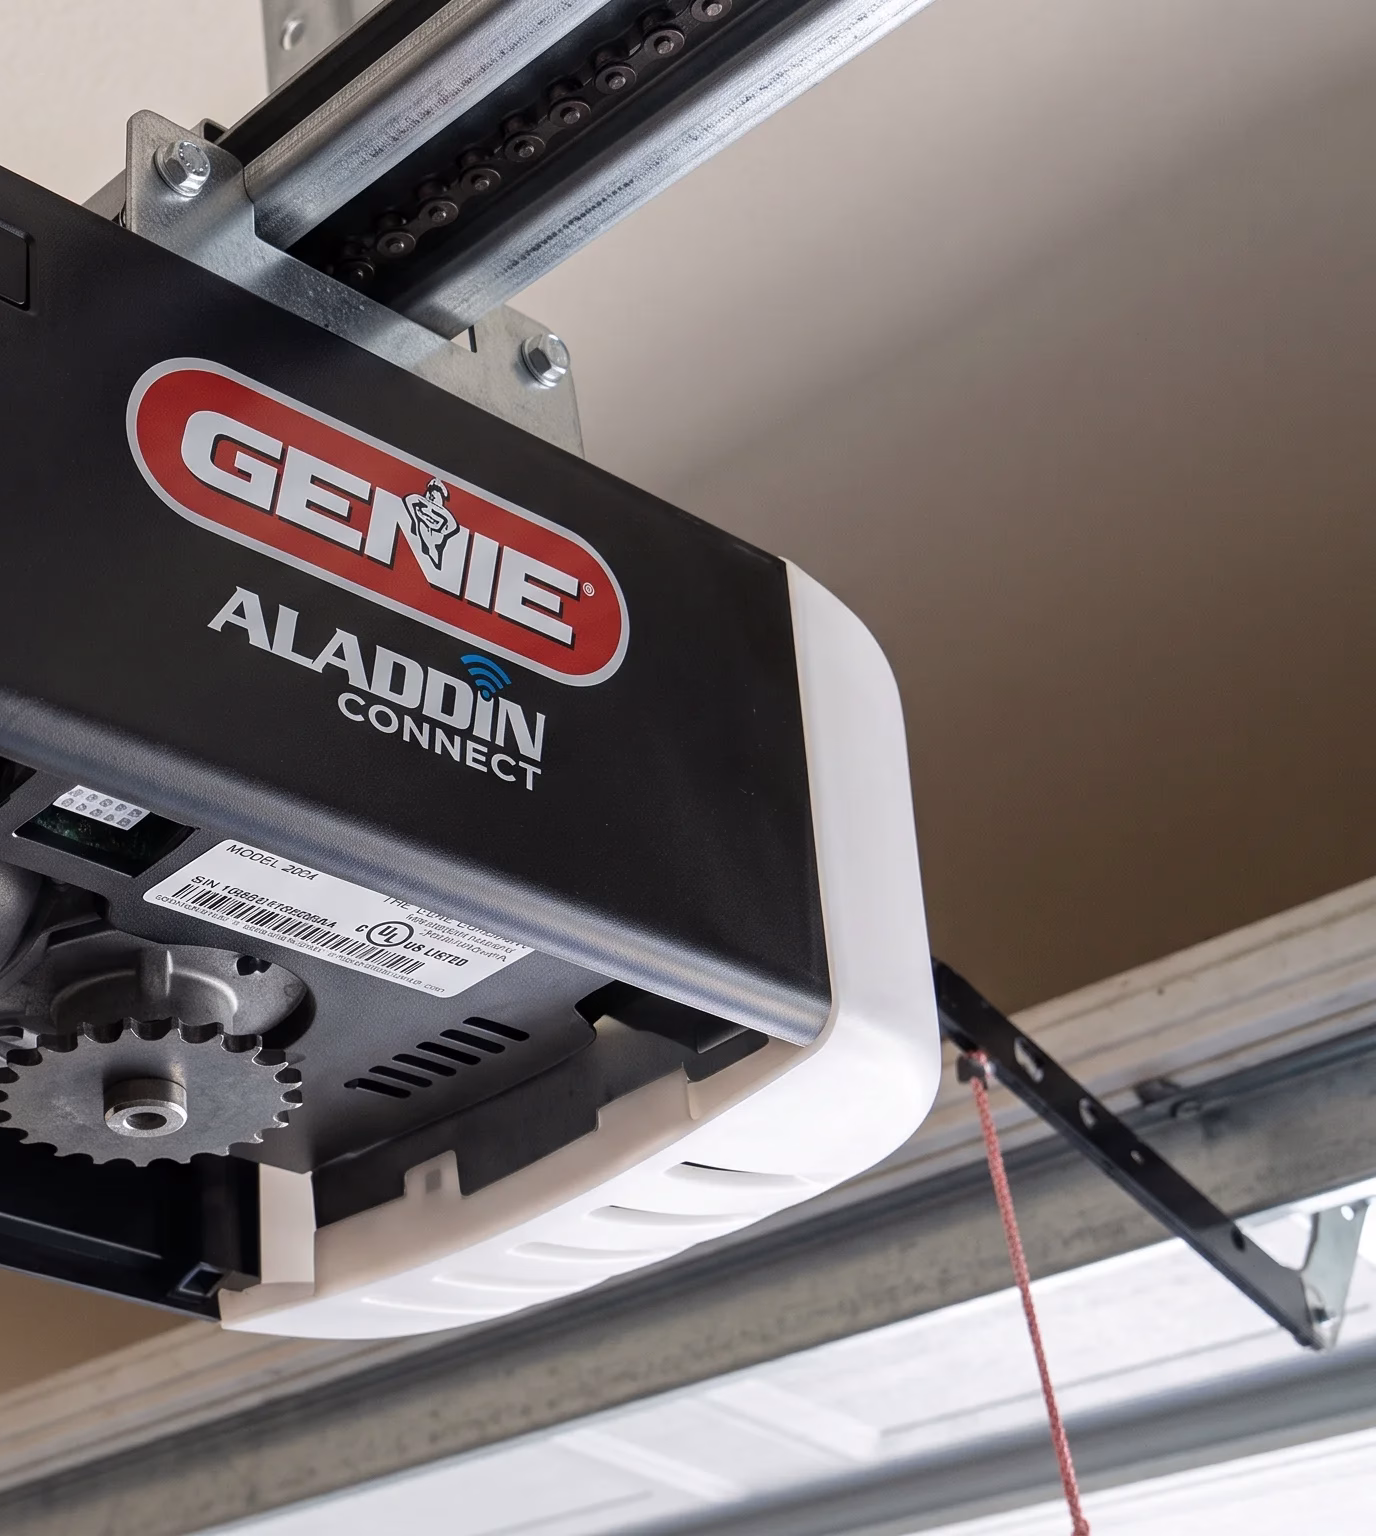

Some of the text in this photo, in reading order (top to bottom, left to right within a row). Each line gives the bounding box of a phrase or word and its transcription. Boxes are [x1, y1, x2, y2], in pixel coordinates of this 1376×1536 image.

[180, 409, 580, 647] GENIE
[337, 692, 542, 791] CONNECT
[226, 844, 279, 869] MODEL
